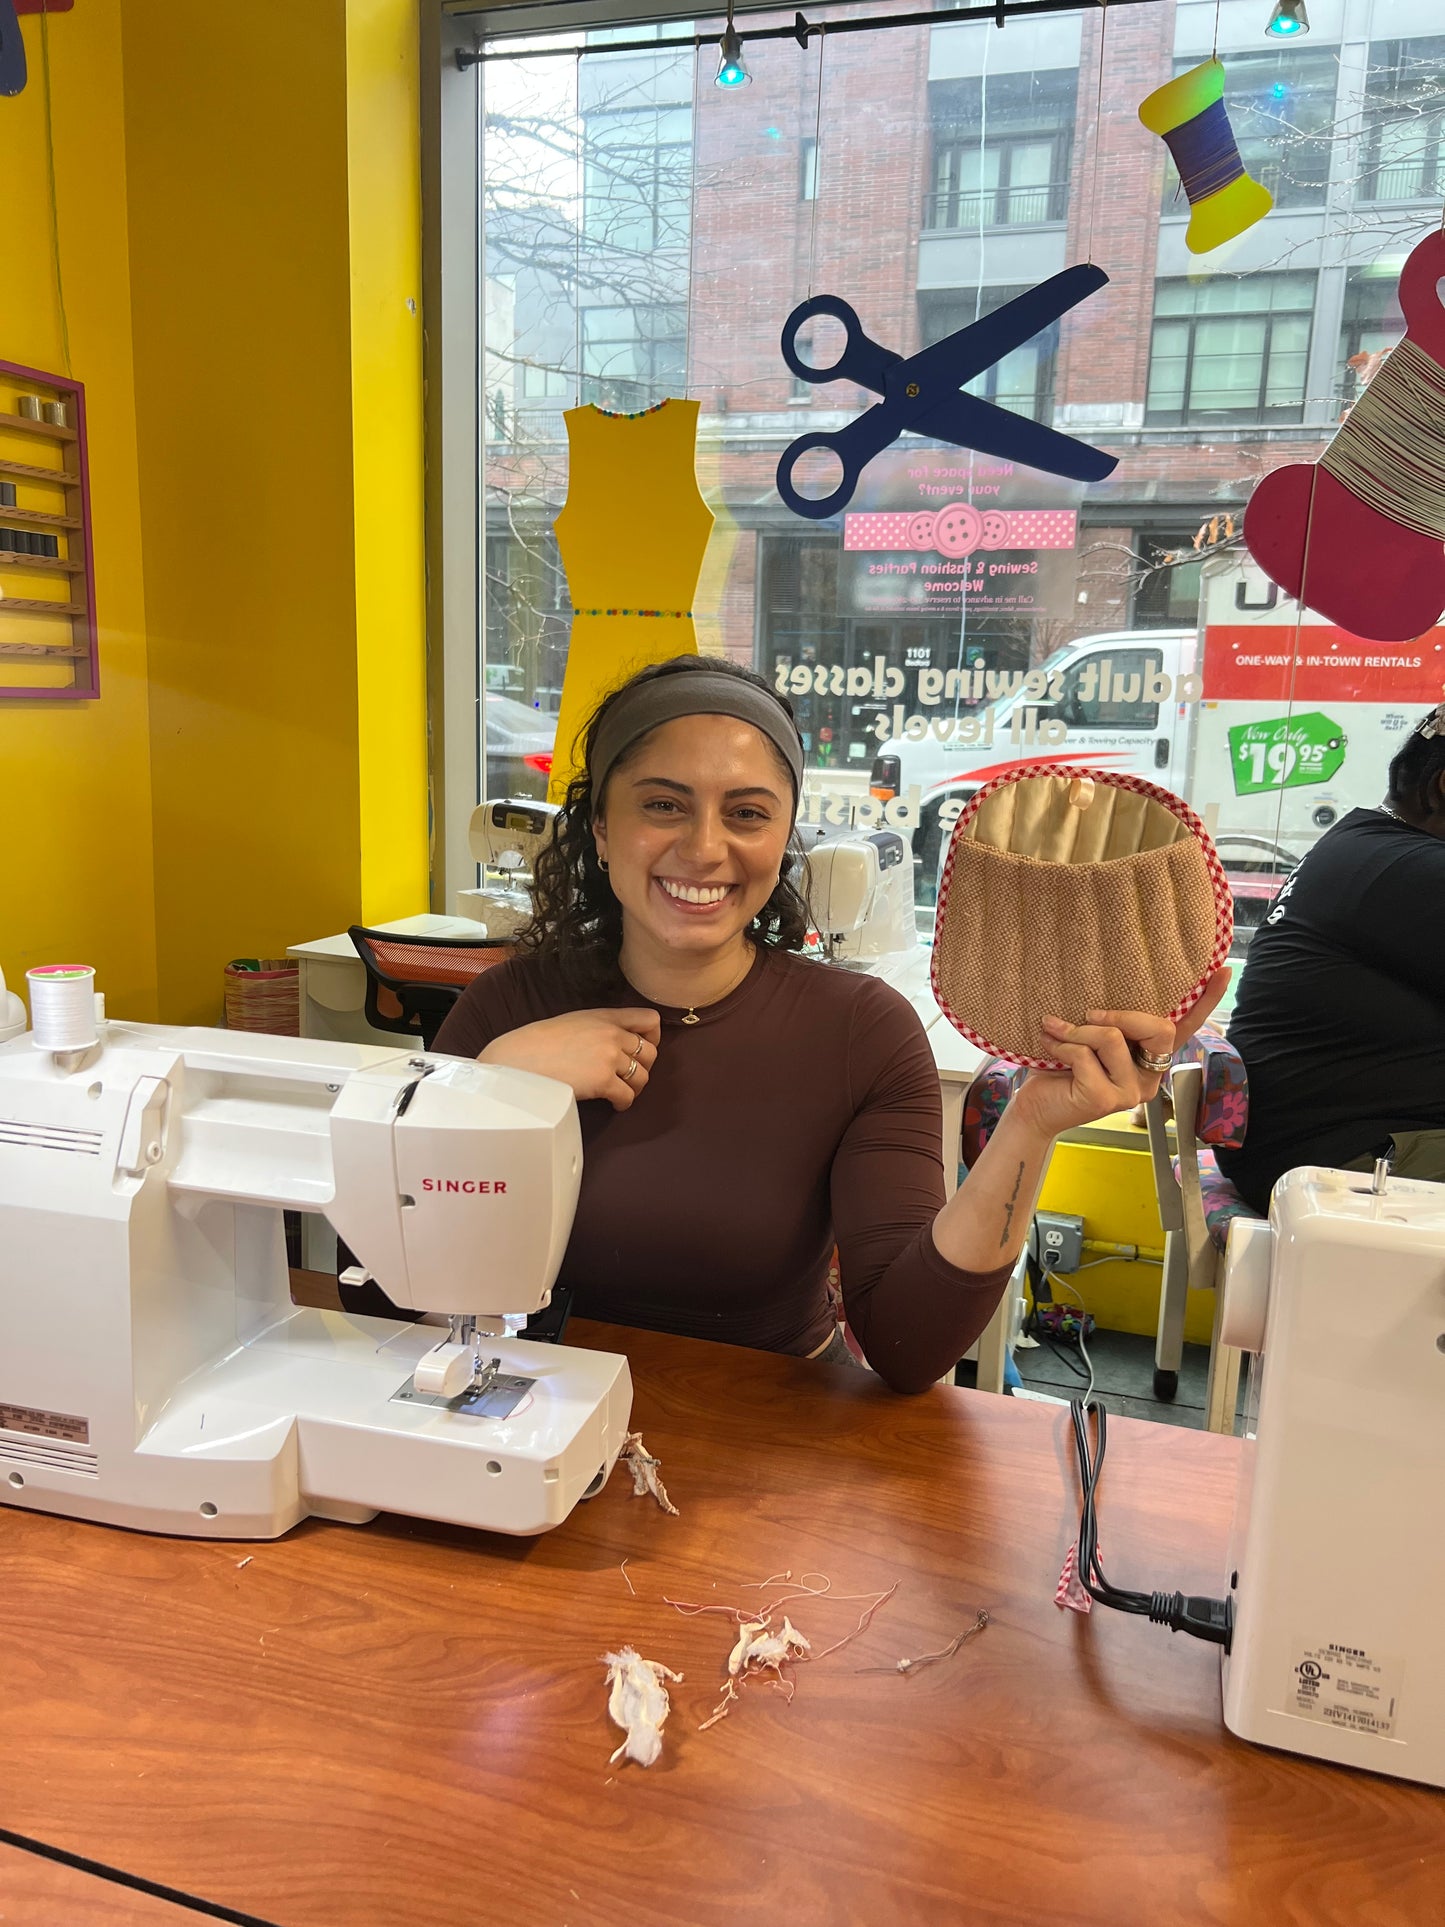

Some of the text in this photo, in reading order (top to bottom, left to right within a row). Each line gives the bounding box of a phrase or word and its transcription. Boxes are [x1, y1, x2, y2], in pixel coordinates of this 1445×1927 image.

[906, 648, 931, 659] 1101
[1235, 656, 1421, 667] ONE-WAY & IN-TOWN RENTALS
[1088, 736, 1117, 747] Towing
[1118, 737, 1155, 746] Capacity
[1241, 725, 1308, 747] Now Only
[422, 1178, 508, 1194] SINGER
[1329, 1643, 1365, 1657] SINGER
